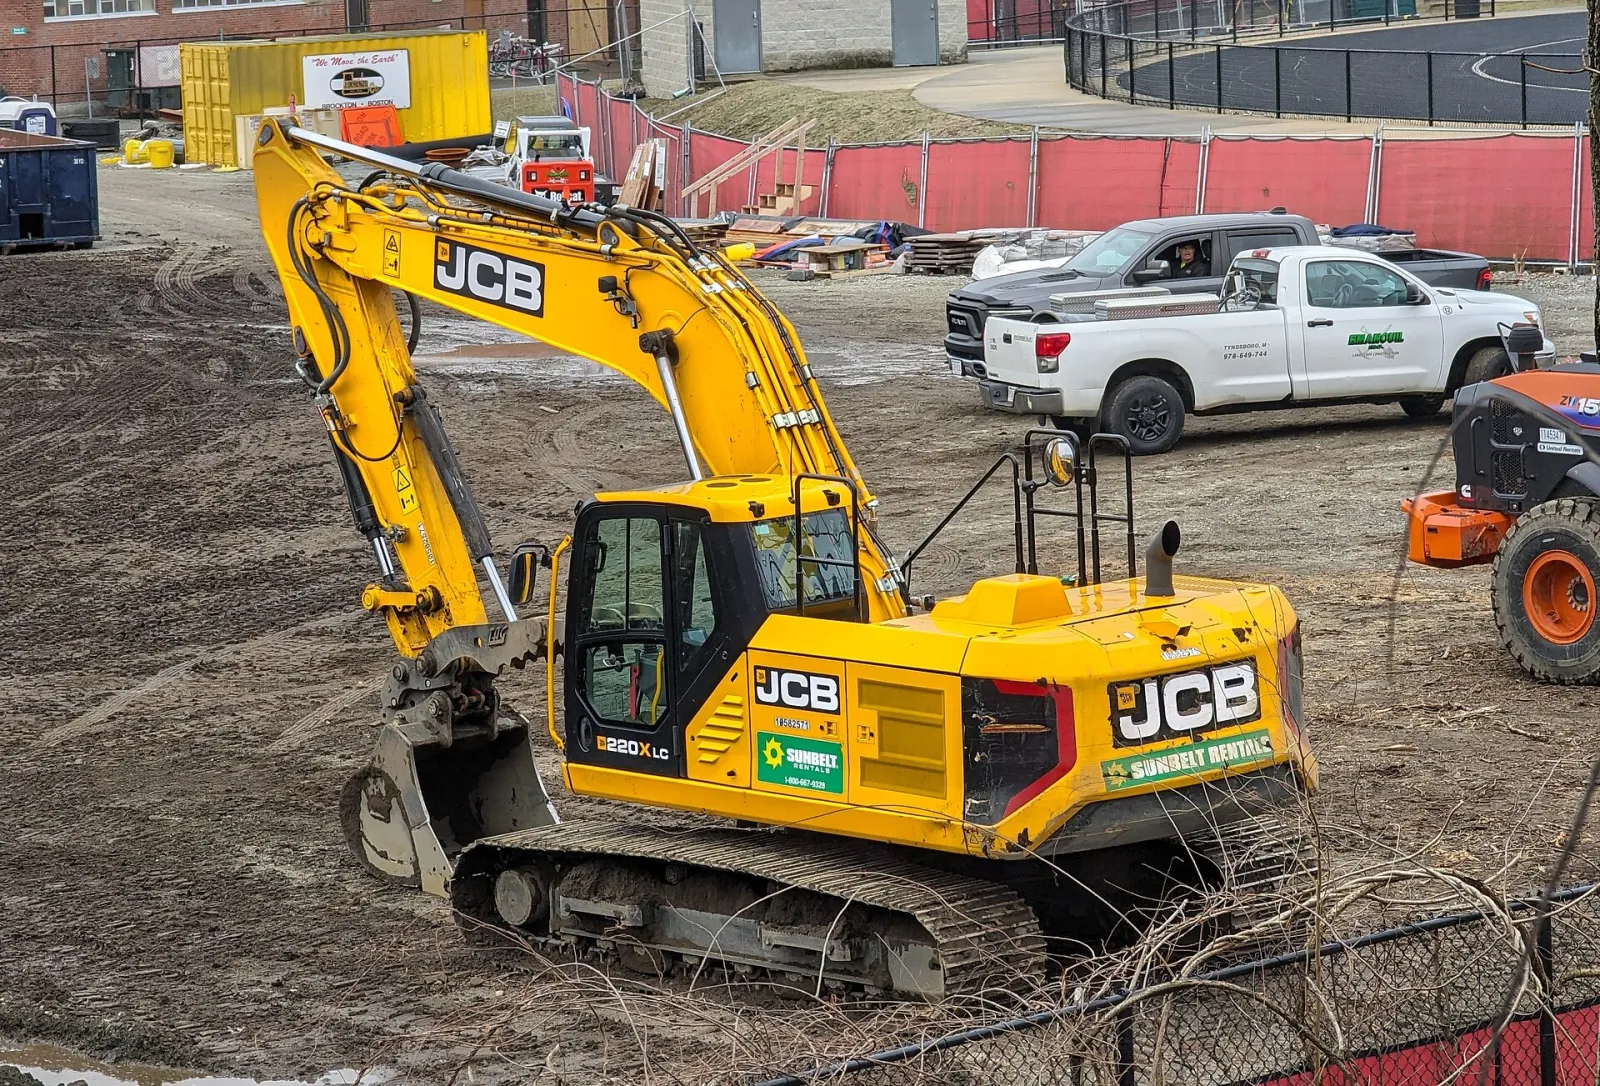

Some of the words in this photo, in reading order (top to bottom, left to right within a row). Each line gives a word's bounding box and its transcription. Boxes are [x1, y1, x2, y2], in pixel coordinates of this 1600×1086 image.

[330, 57, 354, 66] Move
[357, 56, 368, 64] the
[354, 125, 368, 144] ROAD
[436, 246, 542, 311] JCB
[952, 318, 966, 326] RAM
[1578, 398, 1600, 416] 15
[757, 671, 838, 711] JCB
[1119, 664, 1258, 740] JCB
[776, 718, 808, 729] 10582571
[786, 748, 837, 768] SUNBELT
[1130, 750, 1205, 779] SUNBELT
[1208, 736, 1273, 764] RENTALS
[794, 763, 830, 774] RENTALS
